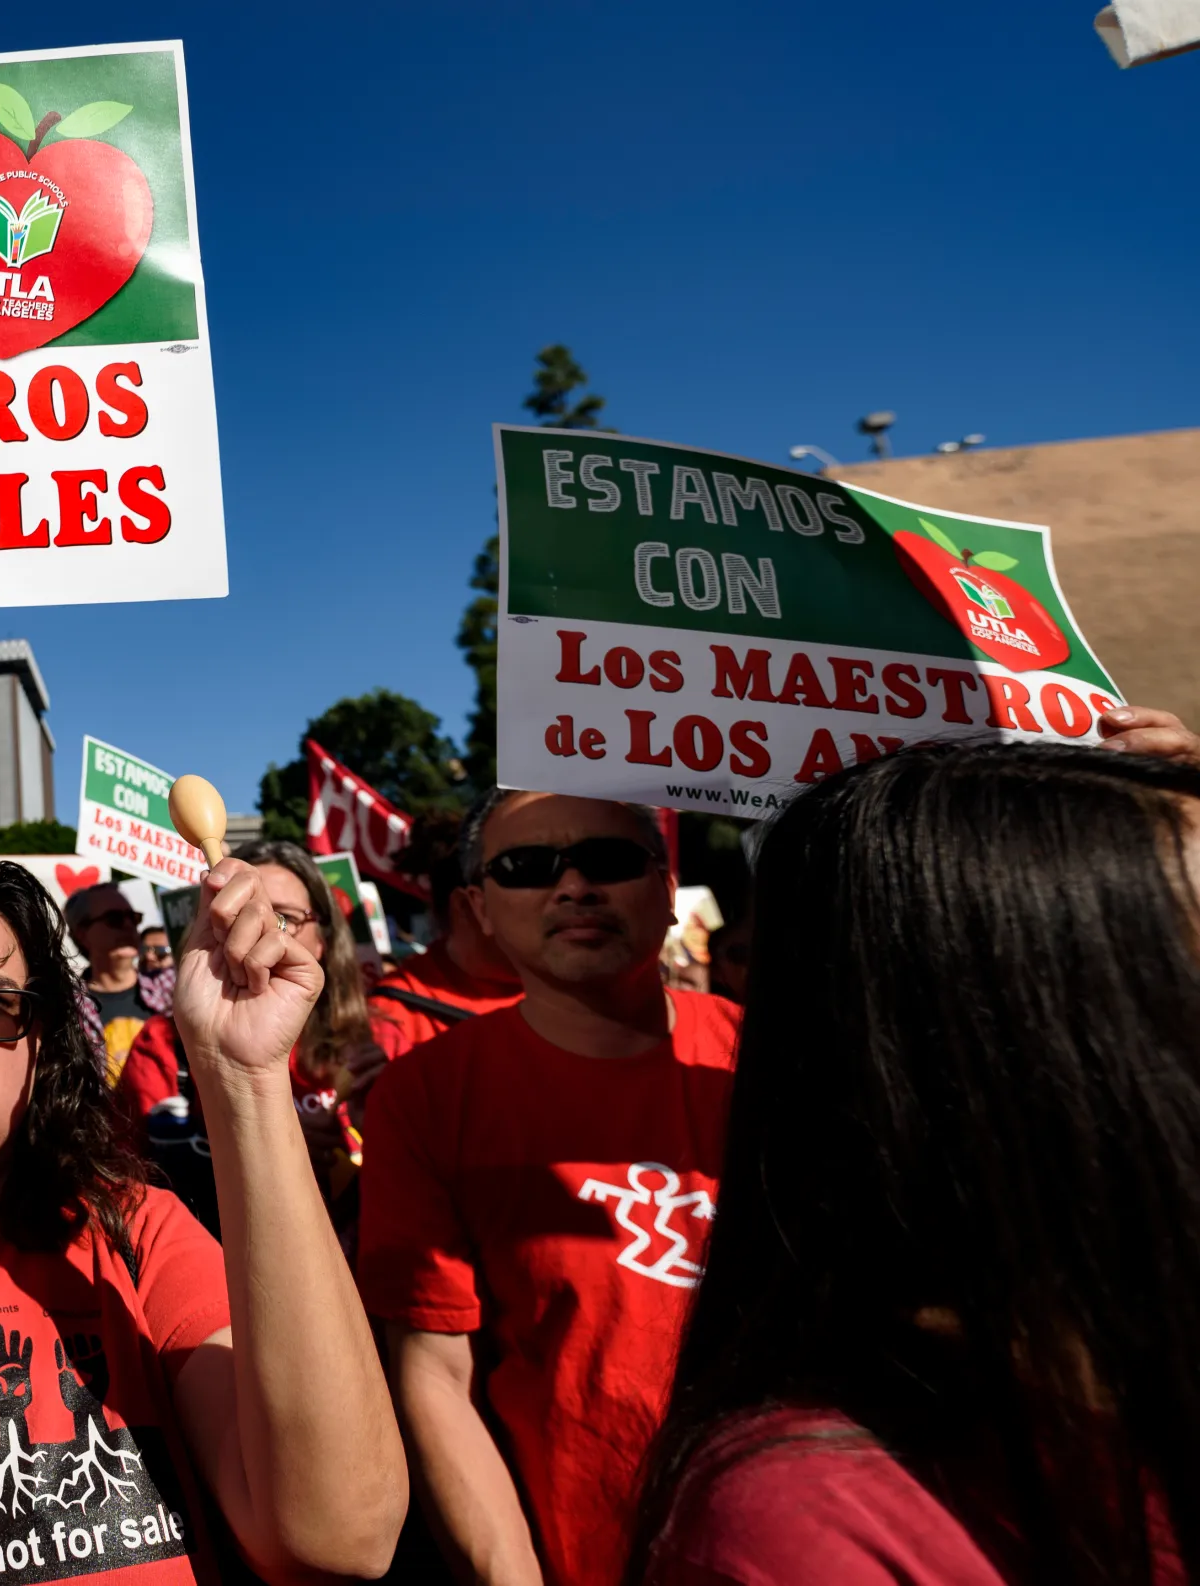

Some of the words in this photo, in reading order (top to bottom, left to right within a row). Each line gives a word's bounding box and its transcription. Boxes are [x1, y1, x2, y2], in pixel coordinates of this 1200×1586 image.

[6, 170, 38, 181] PUBLIC
[38, 175, 69, 208] SCHOOLS
[2, 299, 55, 312] TEACHERS
[543, 448, 866, 545] ESTAMOS
[634, 541, 782, 619] CON
[966, 609, 1036, 646] UTLA
[544, 714, 607, 760] de
[624, 708, 772, 778] LOS
[94, 746, 171, 801] ESTAMOS
[113, 783, 149, 819] CON
[106, 835, 139, 862] LOS
[51, 1520, 109, 1563] for
[119, 1502, 185, 1550] sale
